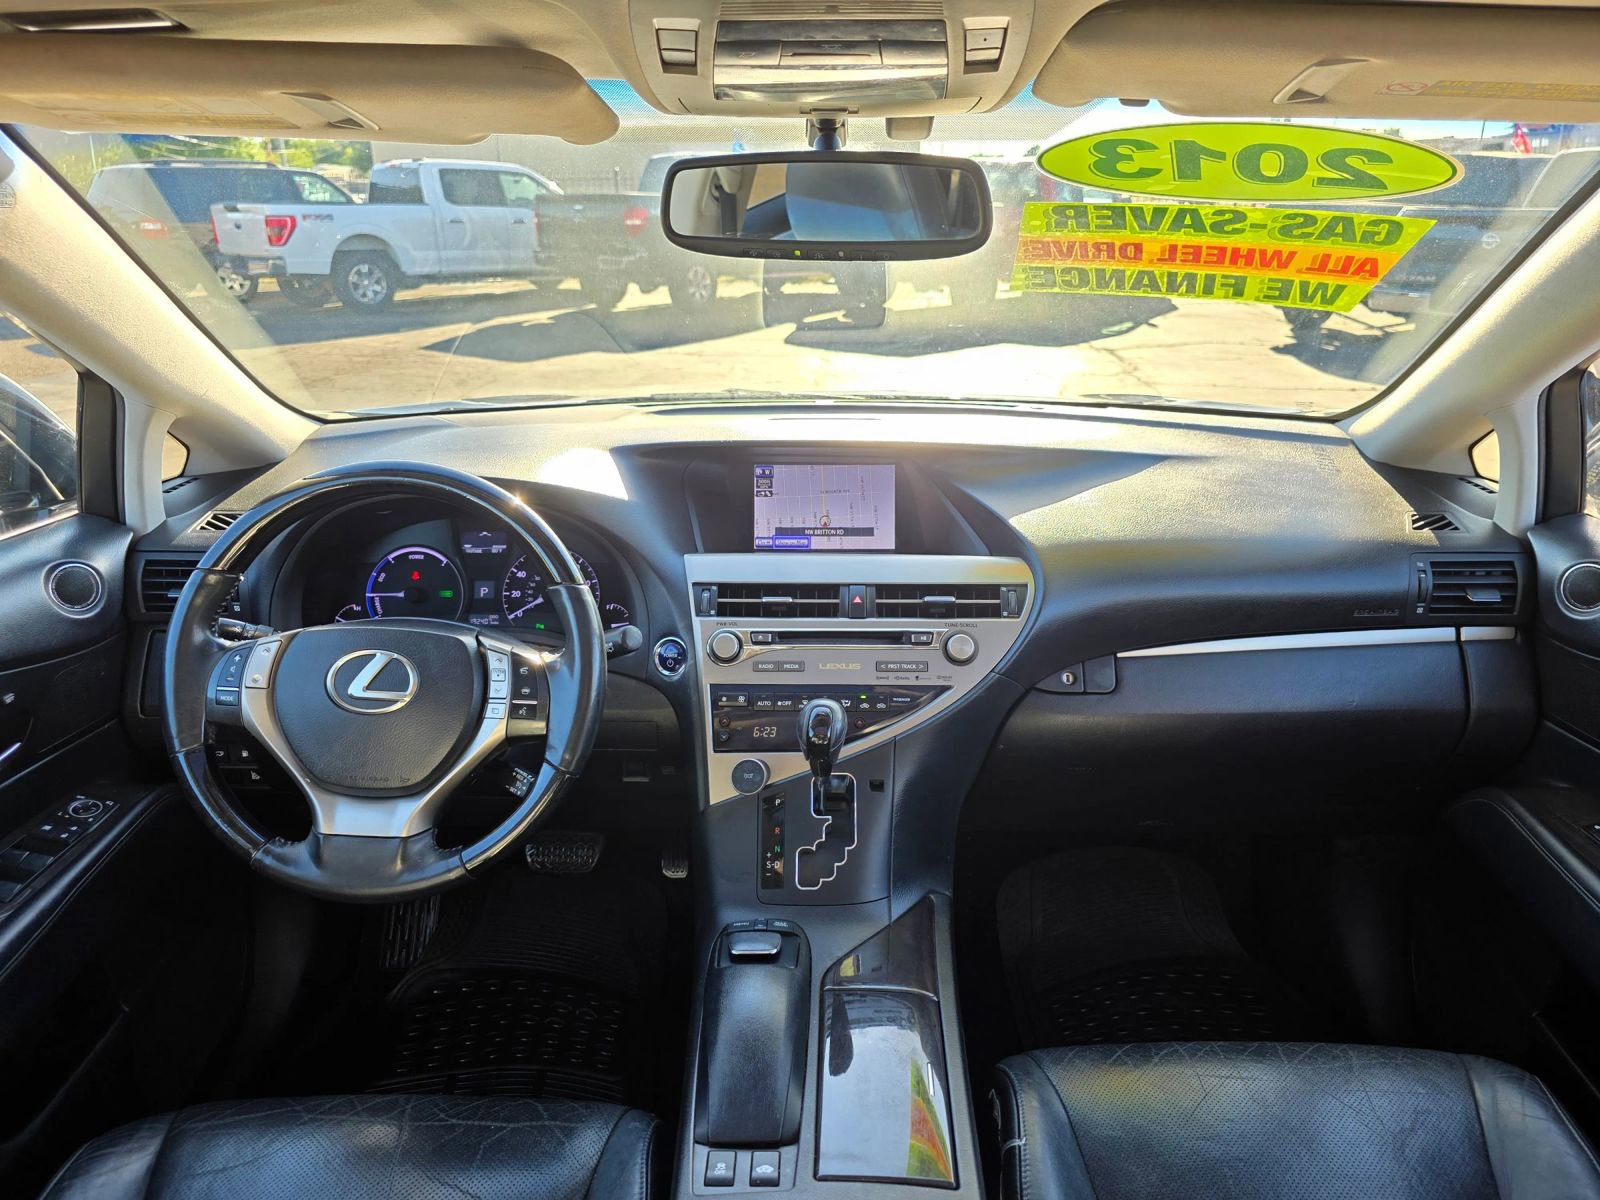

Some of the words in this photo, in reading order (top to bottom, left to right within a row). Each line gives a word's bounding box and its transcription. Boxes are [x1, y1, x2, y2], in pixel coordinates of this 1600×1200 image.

[516, 570, 526, 578] 40
[480, 587, 489, 598] P
[819, 662, 862, 670] LEXUS
[753, 726, 777, 737] 6:23
[774, 826, 781, 834] R
